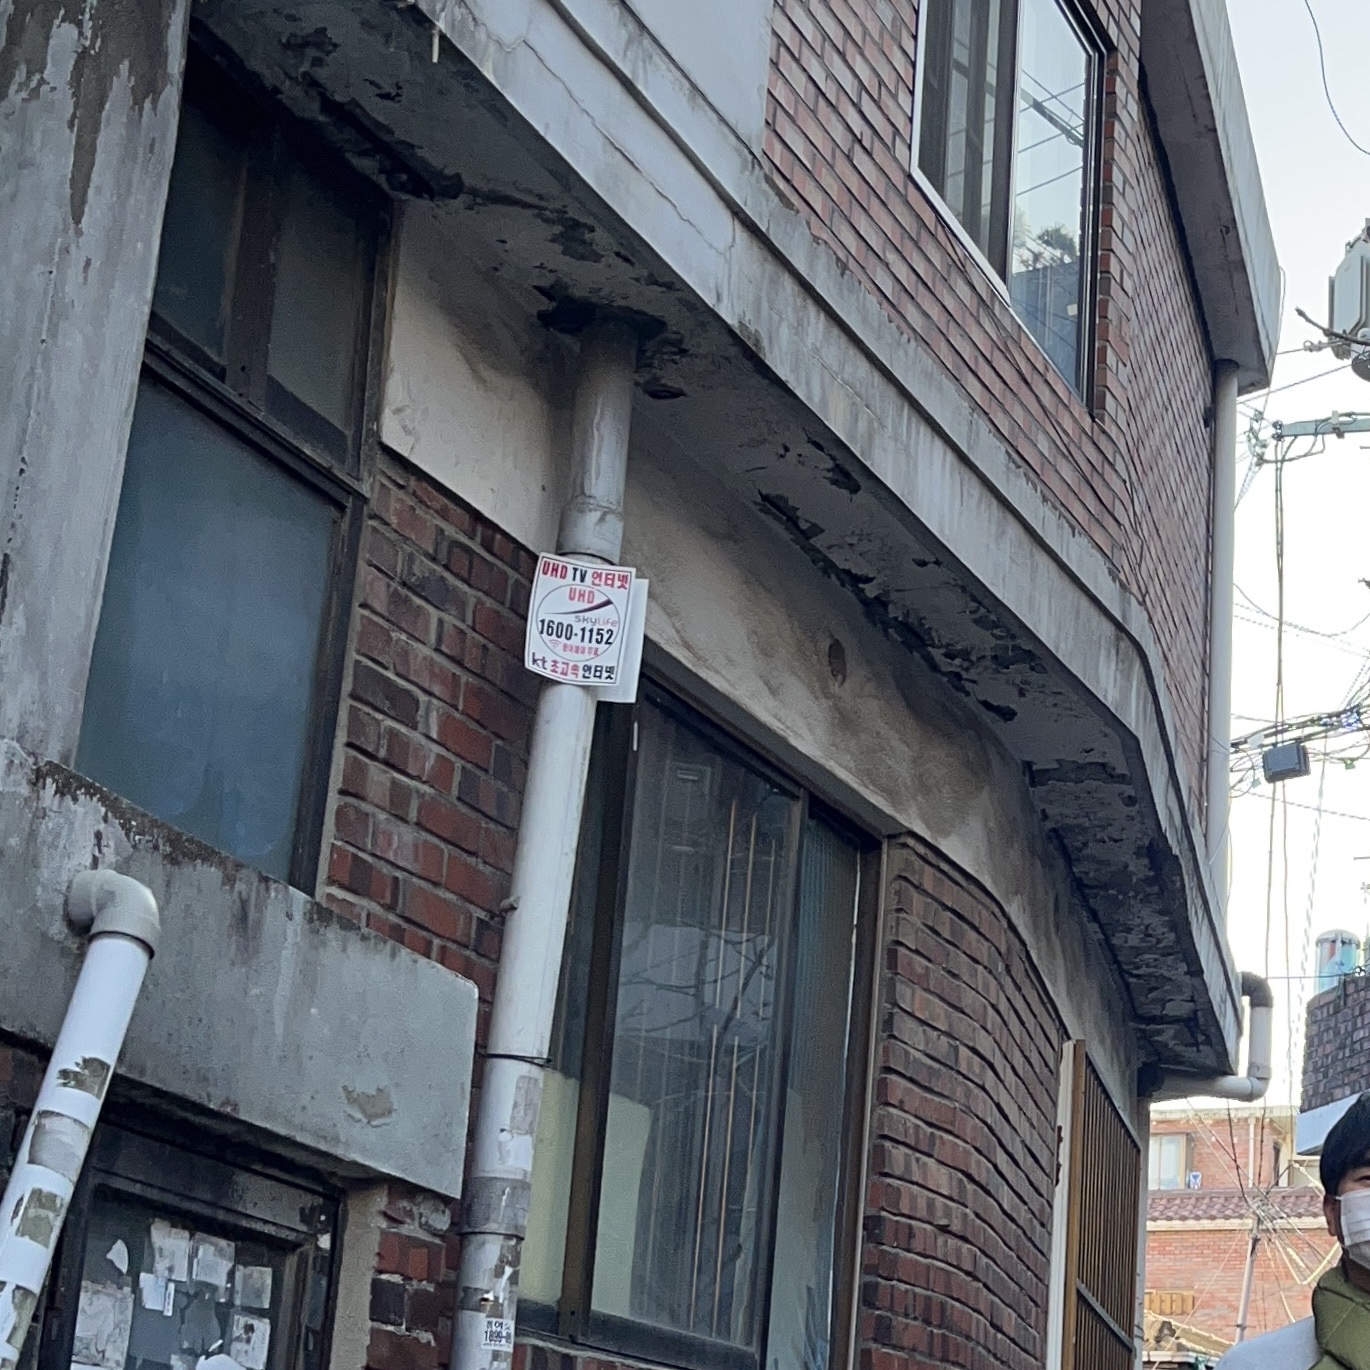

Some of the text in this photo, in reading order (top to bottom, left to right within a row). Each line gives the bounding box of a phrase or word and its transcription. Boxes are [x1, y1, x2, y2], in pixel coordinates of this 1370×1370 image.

[541, 560, 568, 580] UHD
[572, 567, 588, 583] TV
[568, 587, 596, 604] UHD
[539, 618, 614, 645] 1600-1152
[531, 652, 547, 670] kt
[550, 659, 580, 679] 초고속
